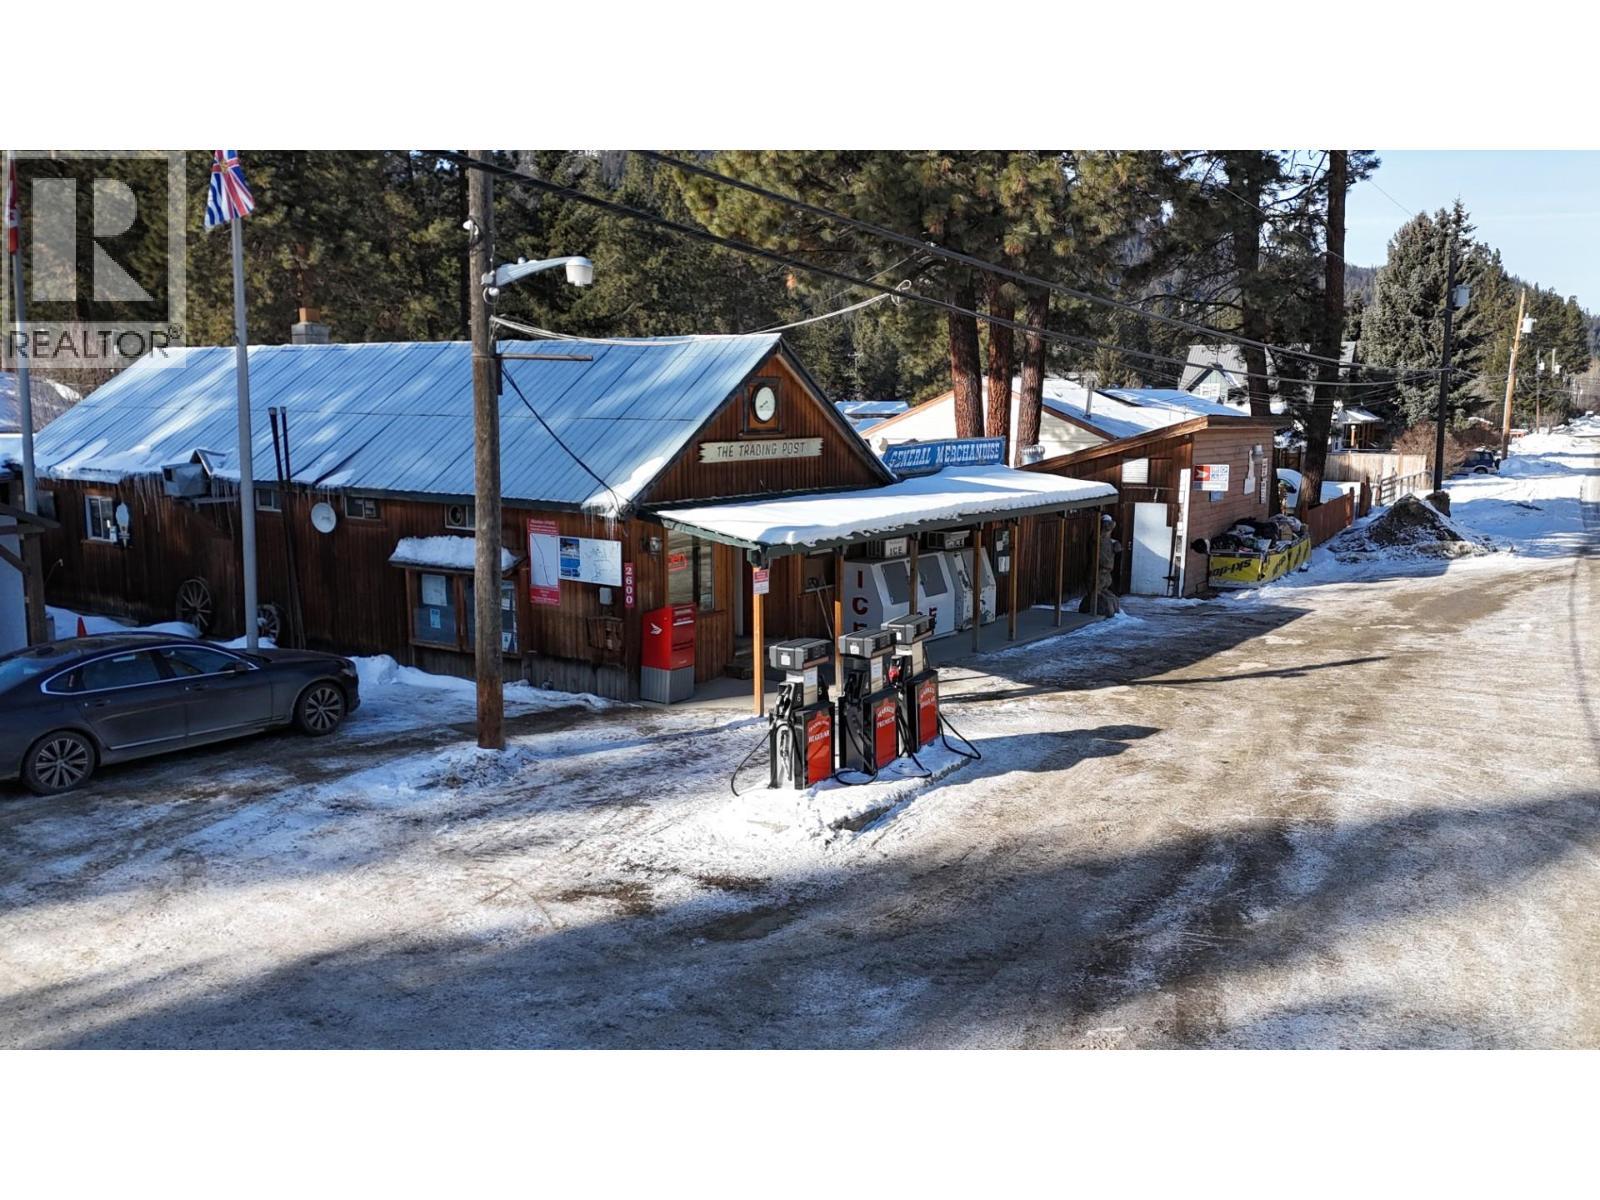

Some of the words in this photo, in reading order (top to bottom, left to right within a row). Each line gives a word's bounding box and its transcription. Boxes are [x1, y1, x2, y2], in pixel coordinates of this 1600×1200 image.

[717, 446, 734, 458] THE
[740, 443, 777, 457] TRADING
[782, 441, 805, 455] POST
[889, 447, 932, 468] GENERAL
[936, 442, 1001, 464] MERCHANDISE
[889, 546, 903, 557] ICE
[625, 566, 633, 604] 2600
